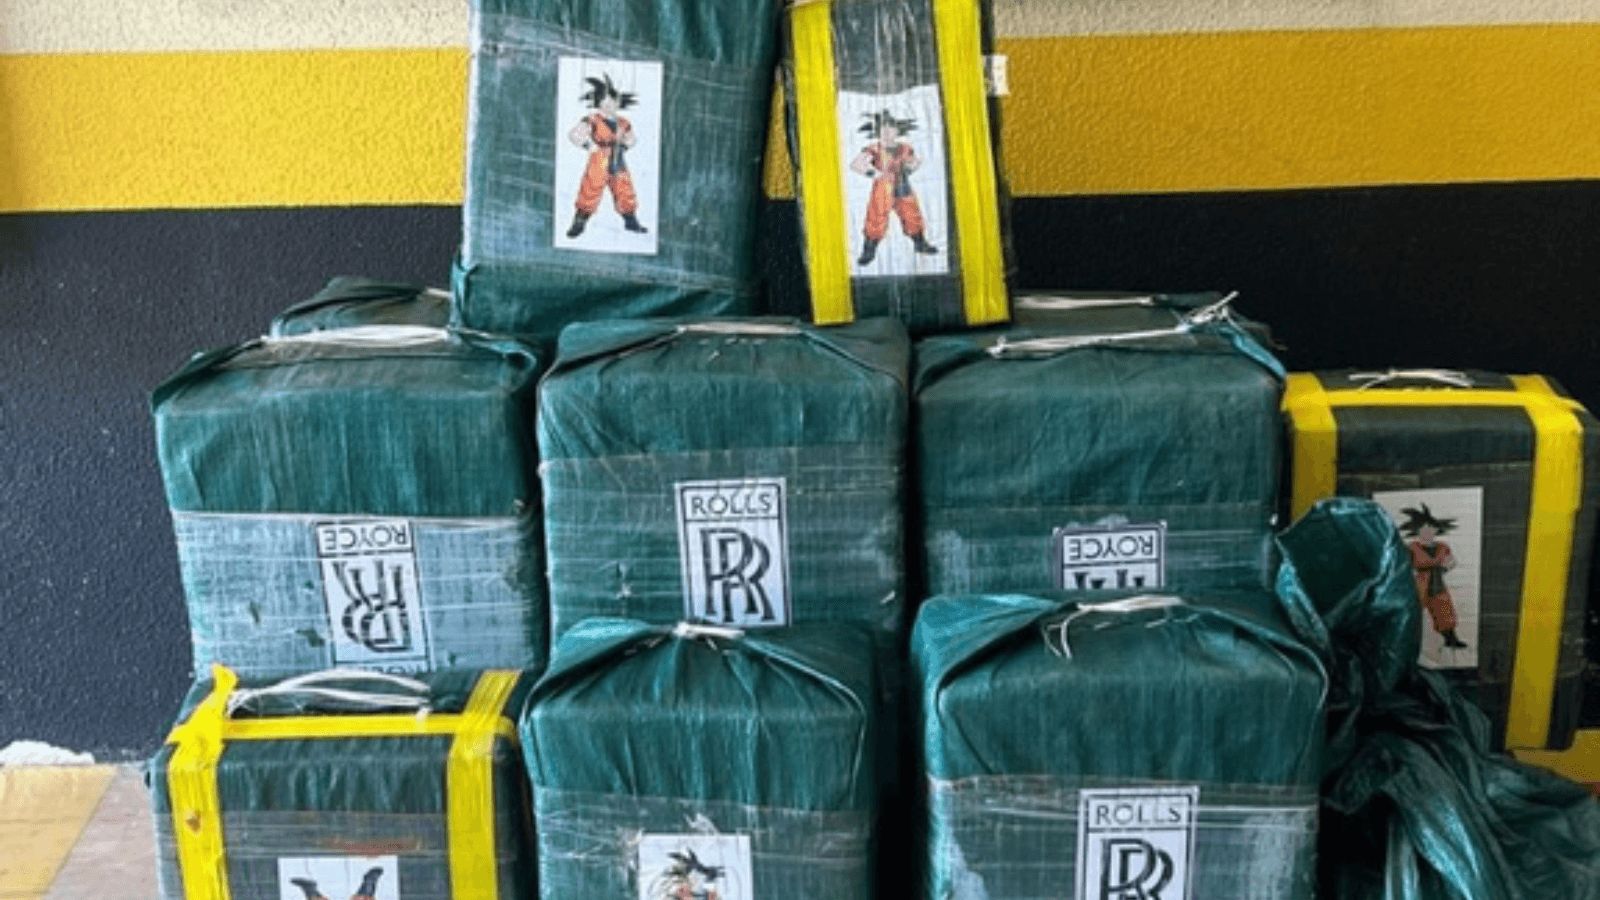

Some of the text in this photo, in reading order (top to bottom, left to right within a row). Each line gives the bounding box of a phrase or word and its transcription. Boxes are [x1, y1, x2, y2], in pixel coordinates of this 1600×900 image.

[691, 492, 772, 515] ROLLS
[323, 525, 407, 550] ROYCE
[1068, 535, 1153, 560] ROYCE
[1096, 804, 1181, 825] ROLLS
